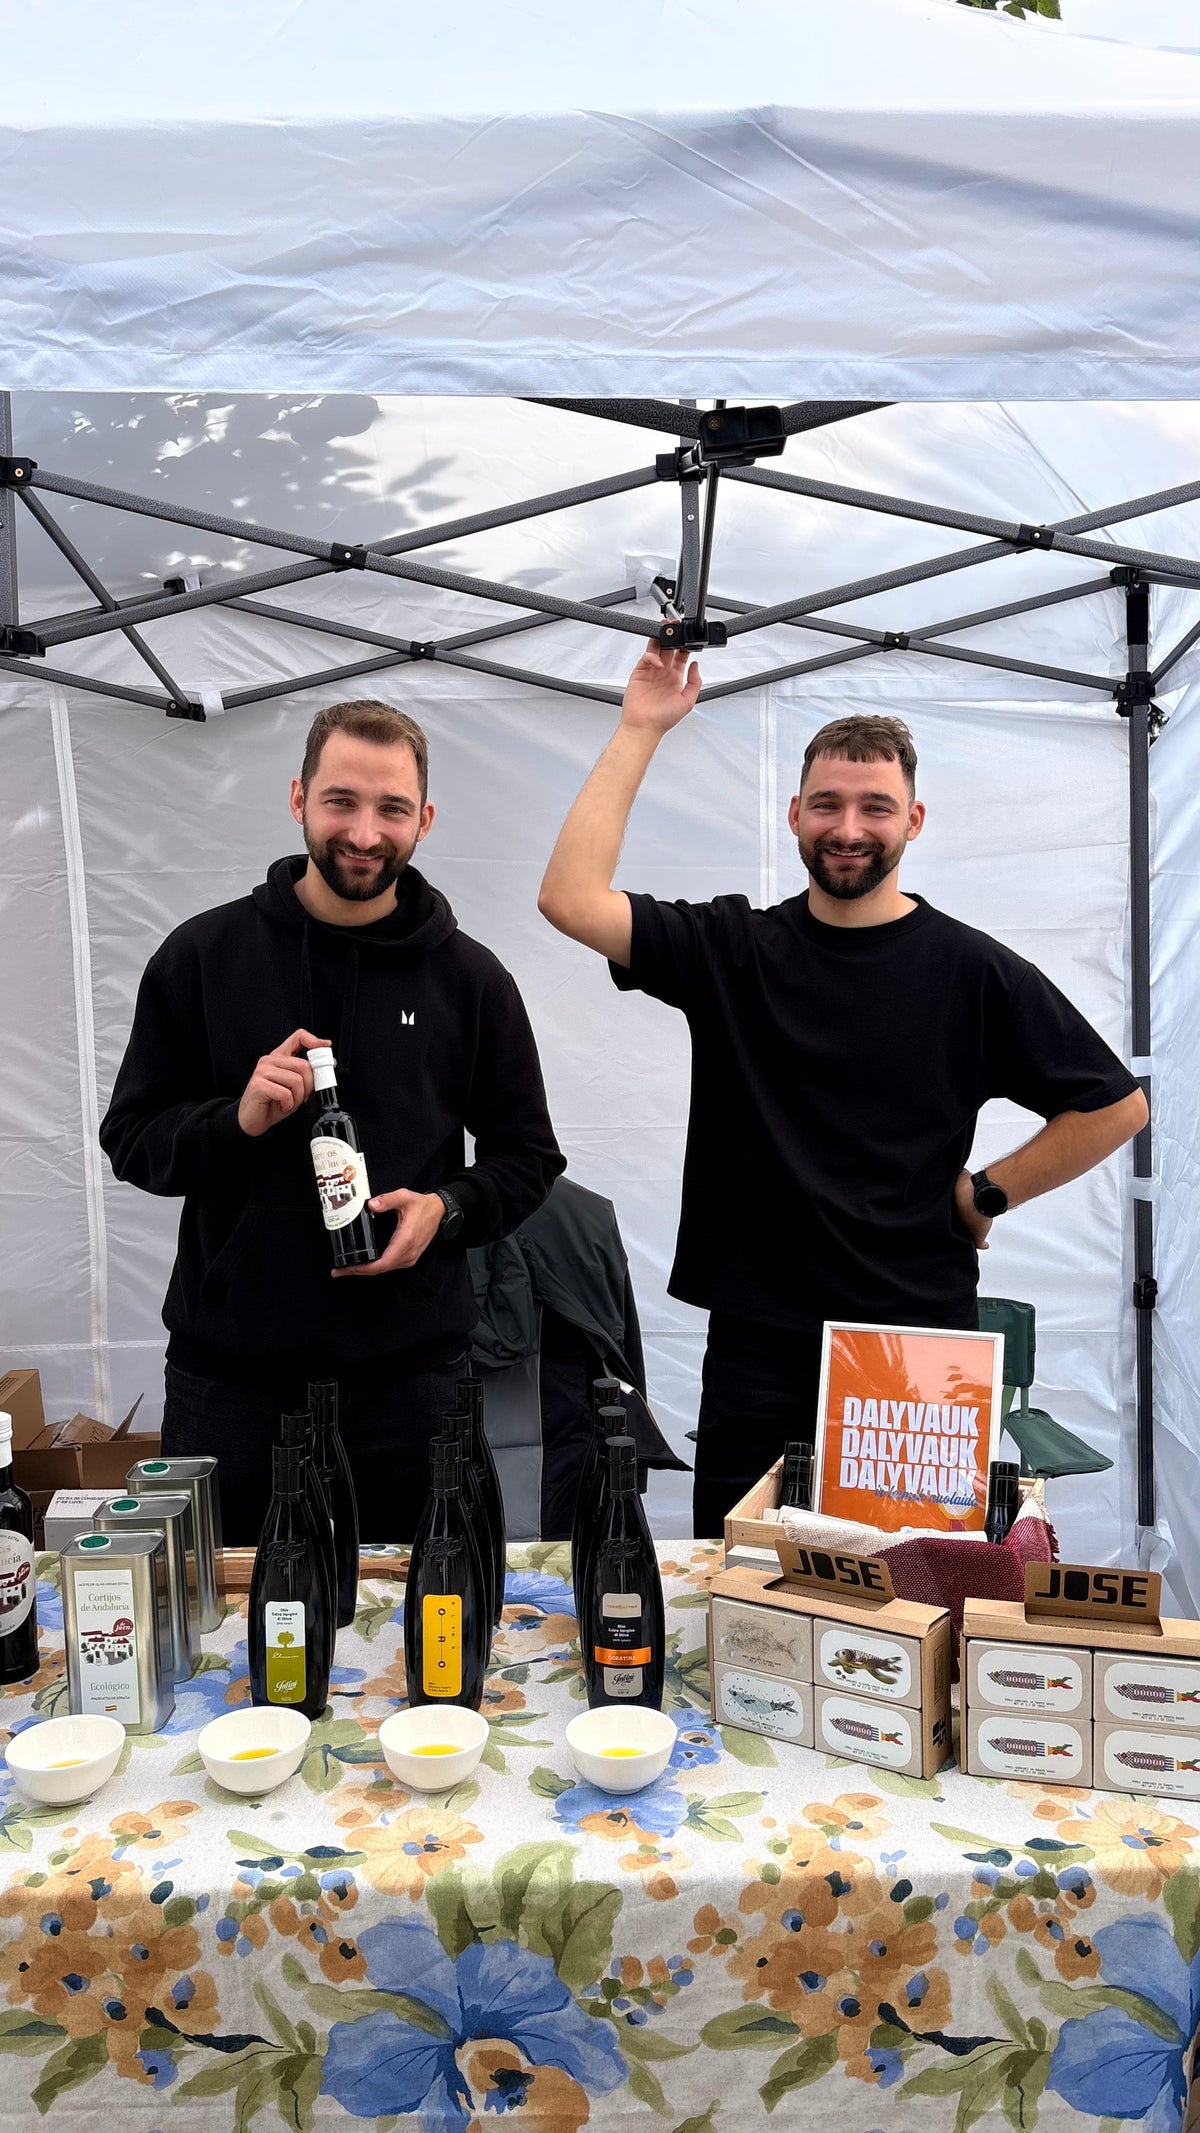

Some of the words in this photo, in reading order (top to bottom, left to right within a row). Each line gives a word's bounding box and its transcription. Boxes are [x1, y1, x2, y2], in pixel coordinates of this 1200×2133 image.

[843, 1396, 980, 1437] DALYVAUK
[841, 1427, 979, 1470] DALYVAUK
[839, 1457, 978, 1499] DALYVAUK
[791, 1548, 886, 1592] JOSE
[1034, 1568, 1149, 1608] JOSE
[81, 1603, 91, 1612] de
[92, 1601, 130, 1612] Andalucía
[88, 1593, 121, 1603] Cortijos
[90, 1681, 130, 1691] Ecológico
